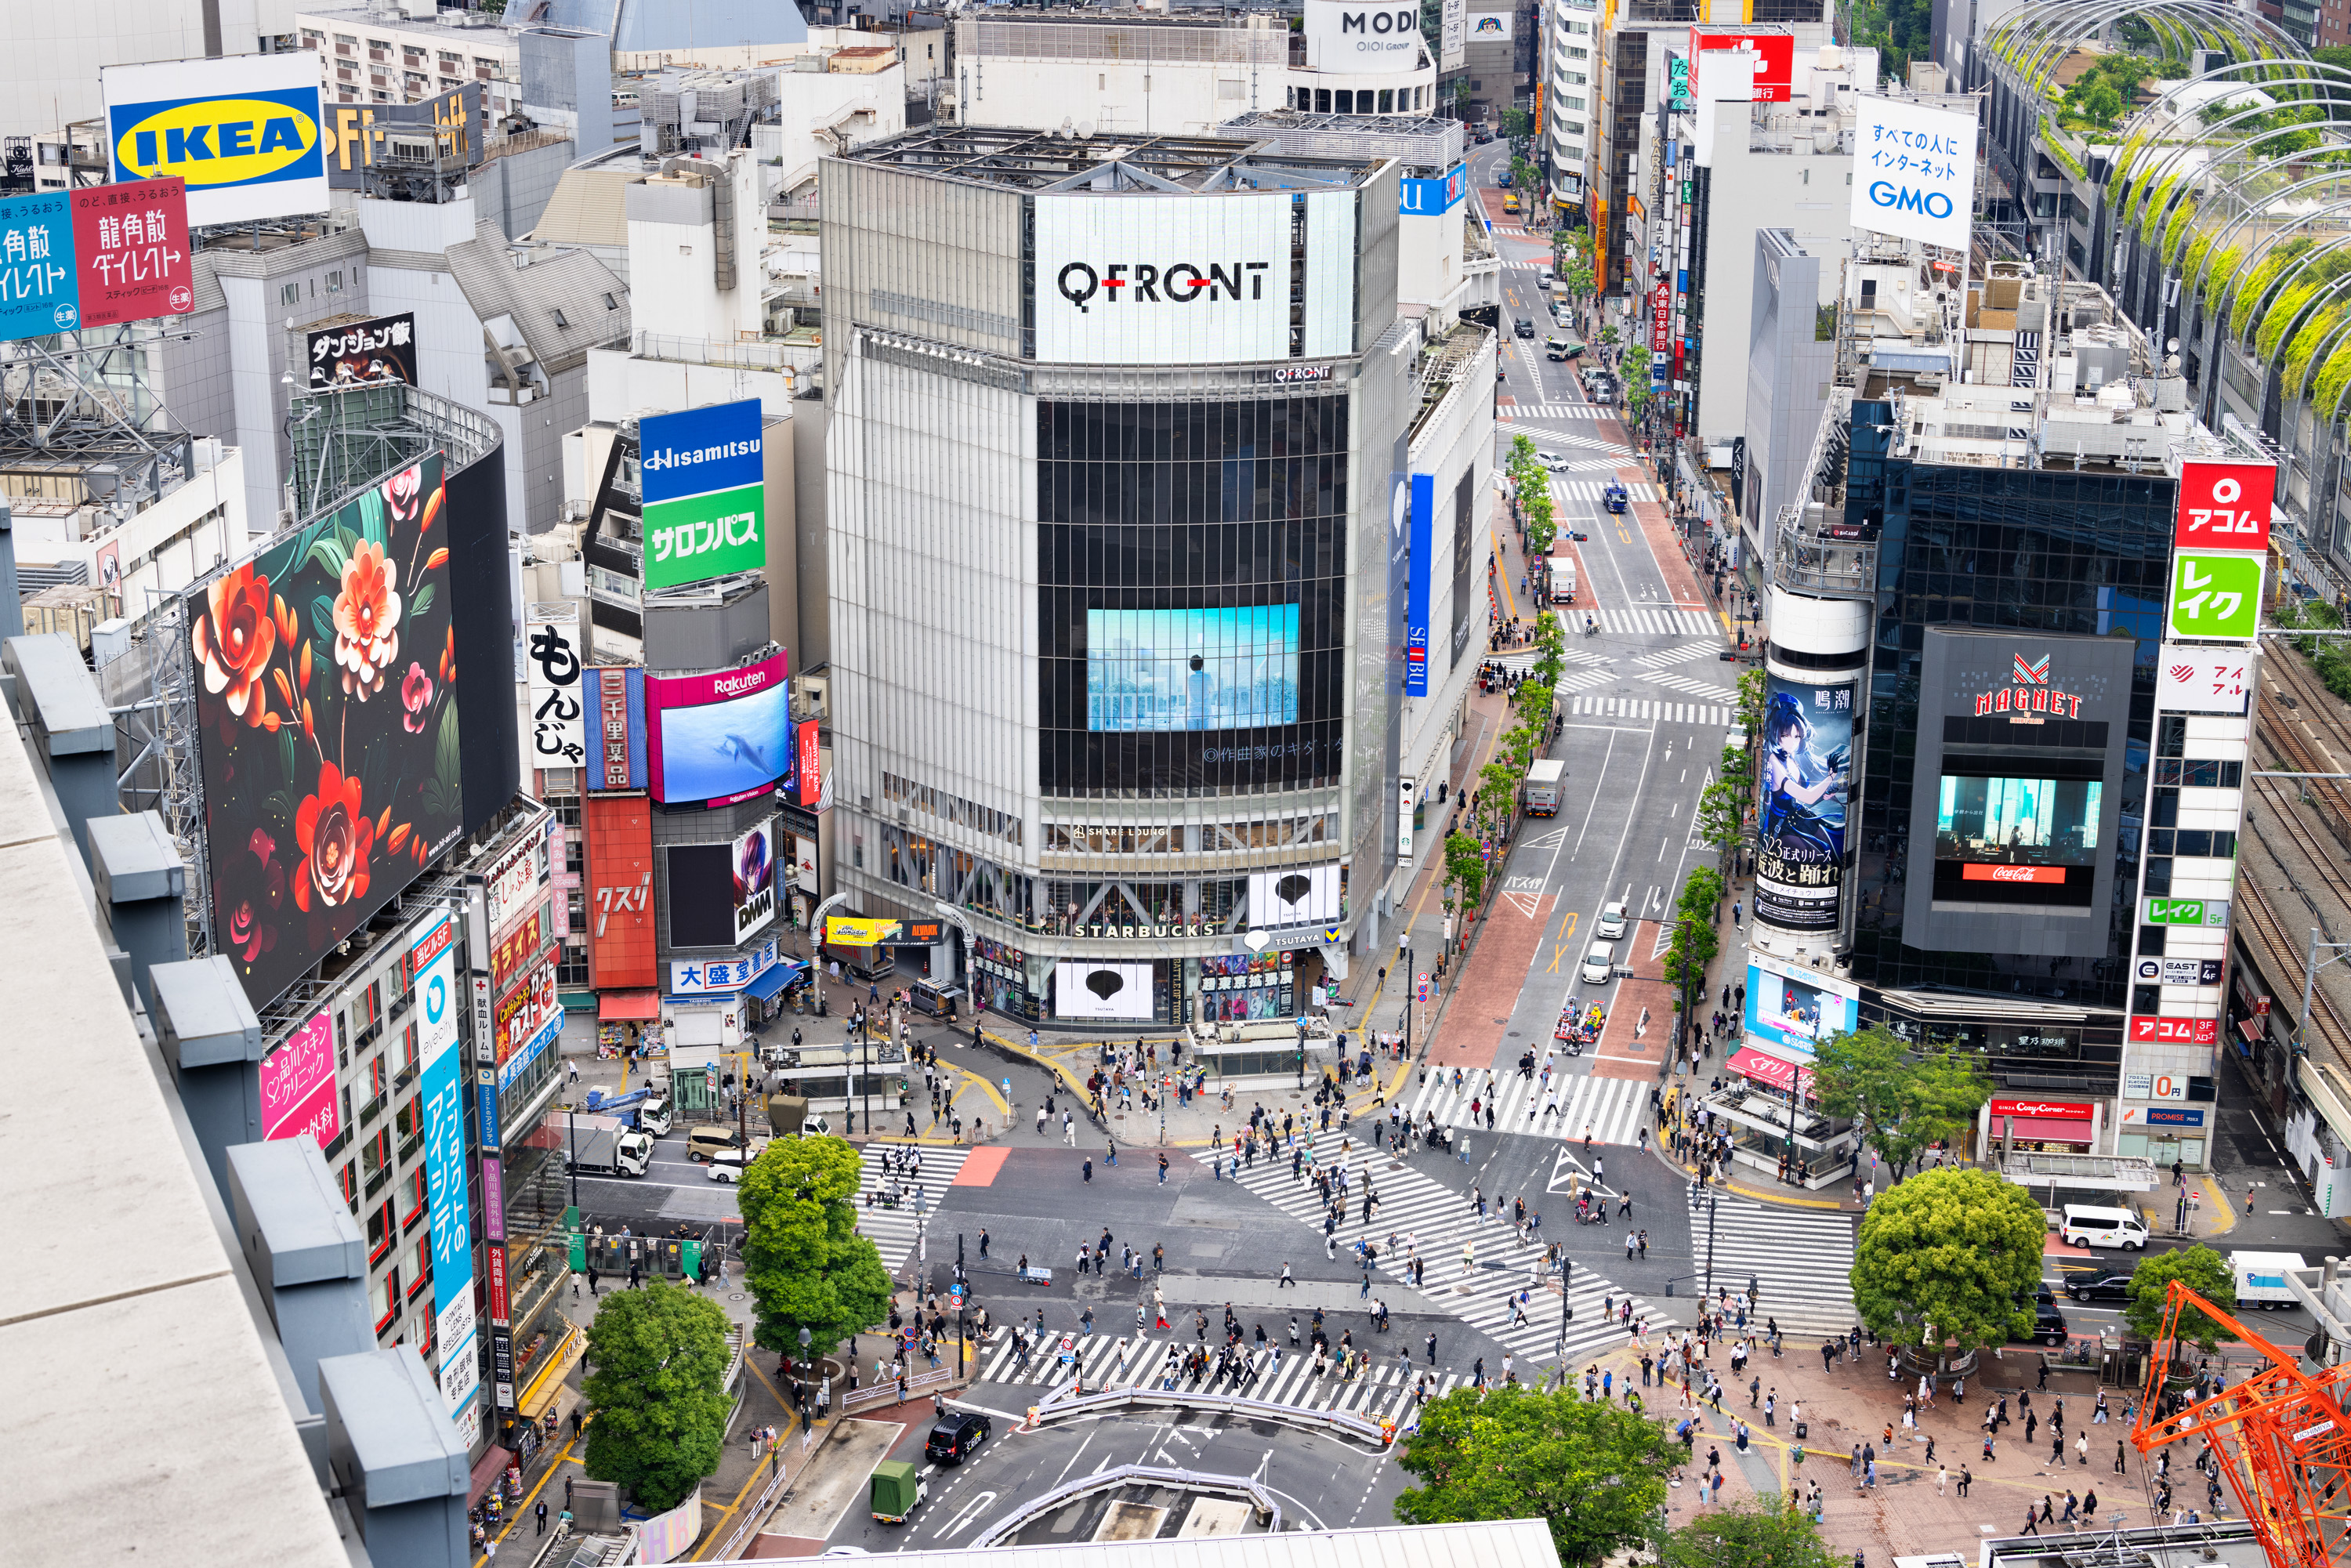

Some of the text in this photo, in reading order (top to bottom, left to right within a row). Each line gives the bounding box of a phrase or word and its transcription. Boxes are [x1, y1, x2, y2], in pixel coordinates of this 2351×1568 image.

[1343, 9, 1417, 34] MODI
[135, 116, 305, 167] IKEA
[1873, 124, 1958, 156] すべての人に
[1649, 136, 1661, 205] KARAOKE
[1871, 150, 1955, 180] インターネット
[1, 201, 63, 220] 接、うるおう
[79, 186, 179, 208] のど、直接、うるおう
[1869, 180, 1953, 219] GMO
[0, 224, 51, 264] 角散
[99, 208, 168, 250] 龍角散
[92, 245, 182, 286] ダイレクト
[106, 287, 139, 299] スティック
[171, 292, 190, 305] 生薬
[1057, 261, 1269, 313] QFRONT
[56, 310, 75, 322] 生薬
[1656, 299, 1668, 349] 東日本銀行
[313, 320, 411, 362] ダンジョン飯
[1274, 366, 1331, 382] QFRONT
[643, 439, 760, 471] Hisamitsu
[652, 511, 759, 563] サロンパス
[2189, 509, 2259, 534] アコム
[1408, 626, 1425, 686] SEIBU
[530, 625, 584, 764] もんじゃ
[714, 671, 766, 695] Rakuten
[1815, 690, 1849, 711] 鳴潮
[1975, 687, 2082, 719] MAGNET
[603, 675, 628, 784] 三千里薬品
[730, 789, 759, 802] Rakuten Vision
[1128, 827, 1169, 836] LOUNG
[552, 827, 564, 871] お好み焼
[1783, 847, 1831, 863] 正式リリース
[502, 859, 533, 904] しゃぶ葉
[1505, 875, 1544, 889] バス停
[1757, 852, 1839, 885] 荒波と踊れ
[1992, 866, 2037, 881] Coca-Cola
[556, 890, 567, 936] もんじゃ焼
[596, 871, 652, 938] クスリ
[738, 888, 772, 932] DMM
[2152, 903, 2222, 924] レイク 5F
[417, 925, 448, 968] 当ビル5F
[912, 925, 938, 936] ALVARK
[1074, 925, 1214, 938] STARBUCKS
[1275, 934, 1320, 946] TSUTAYA
[531, 960, 554, 996] ガスト
[680, 941, 773, 987] 大盛堂書店
[1795, 969, 1819, 984] STARTS
[2202, 970, 2215, 980] 4F
[476, 998, 490, 1052] 献血ルーム
[509, 1001, 538, 1049] ガスト
[1172, 1000, 1181, 1025] TOKYO
[423, 1018, 453, 1054] eyecity
[1791, 1037, 1816, 1053] STARTS
[1892, 1031, 1912, 1042] COFFEE
[2018, 1035, 2066, 1047] 星乃珈琲
[2139, 1022, 2190, 1037] アコム
[281, 1026, 327, 1081] 品川スキン
[509, 1027, 552, 1081] 英会話イーオン
[1749, 1056, 1786, 1076] くすり
[282, 1052, 324, 1106] クリニック
[2157, 1076, 2180, 1096] 0円
[484, 1086, 494, 1144] コンタクトのアイシティ
[2016, 1103, 2039, 1114] Cozy
[2039, 1104, 2065, 1113] Corner
[427, 1091, 451, 1264] アイシティ
[445, 1077, 466, 1250] コンタクトの
[488, 1176, 500, 1227] 品川美容外科
[491, 1248, 504, 1287] 外貨両替
[445, 1296, 466, 1326] CONTACT
[450, 1313, 462, 1332] LENS
[443, 1314, 472, 1353] SPECIALISTS
[2296, 1423, 2331, 1439] UCHIMIYA
